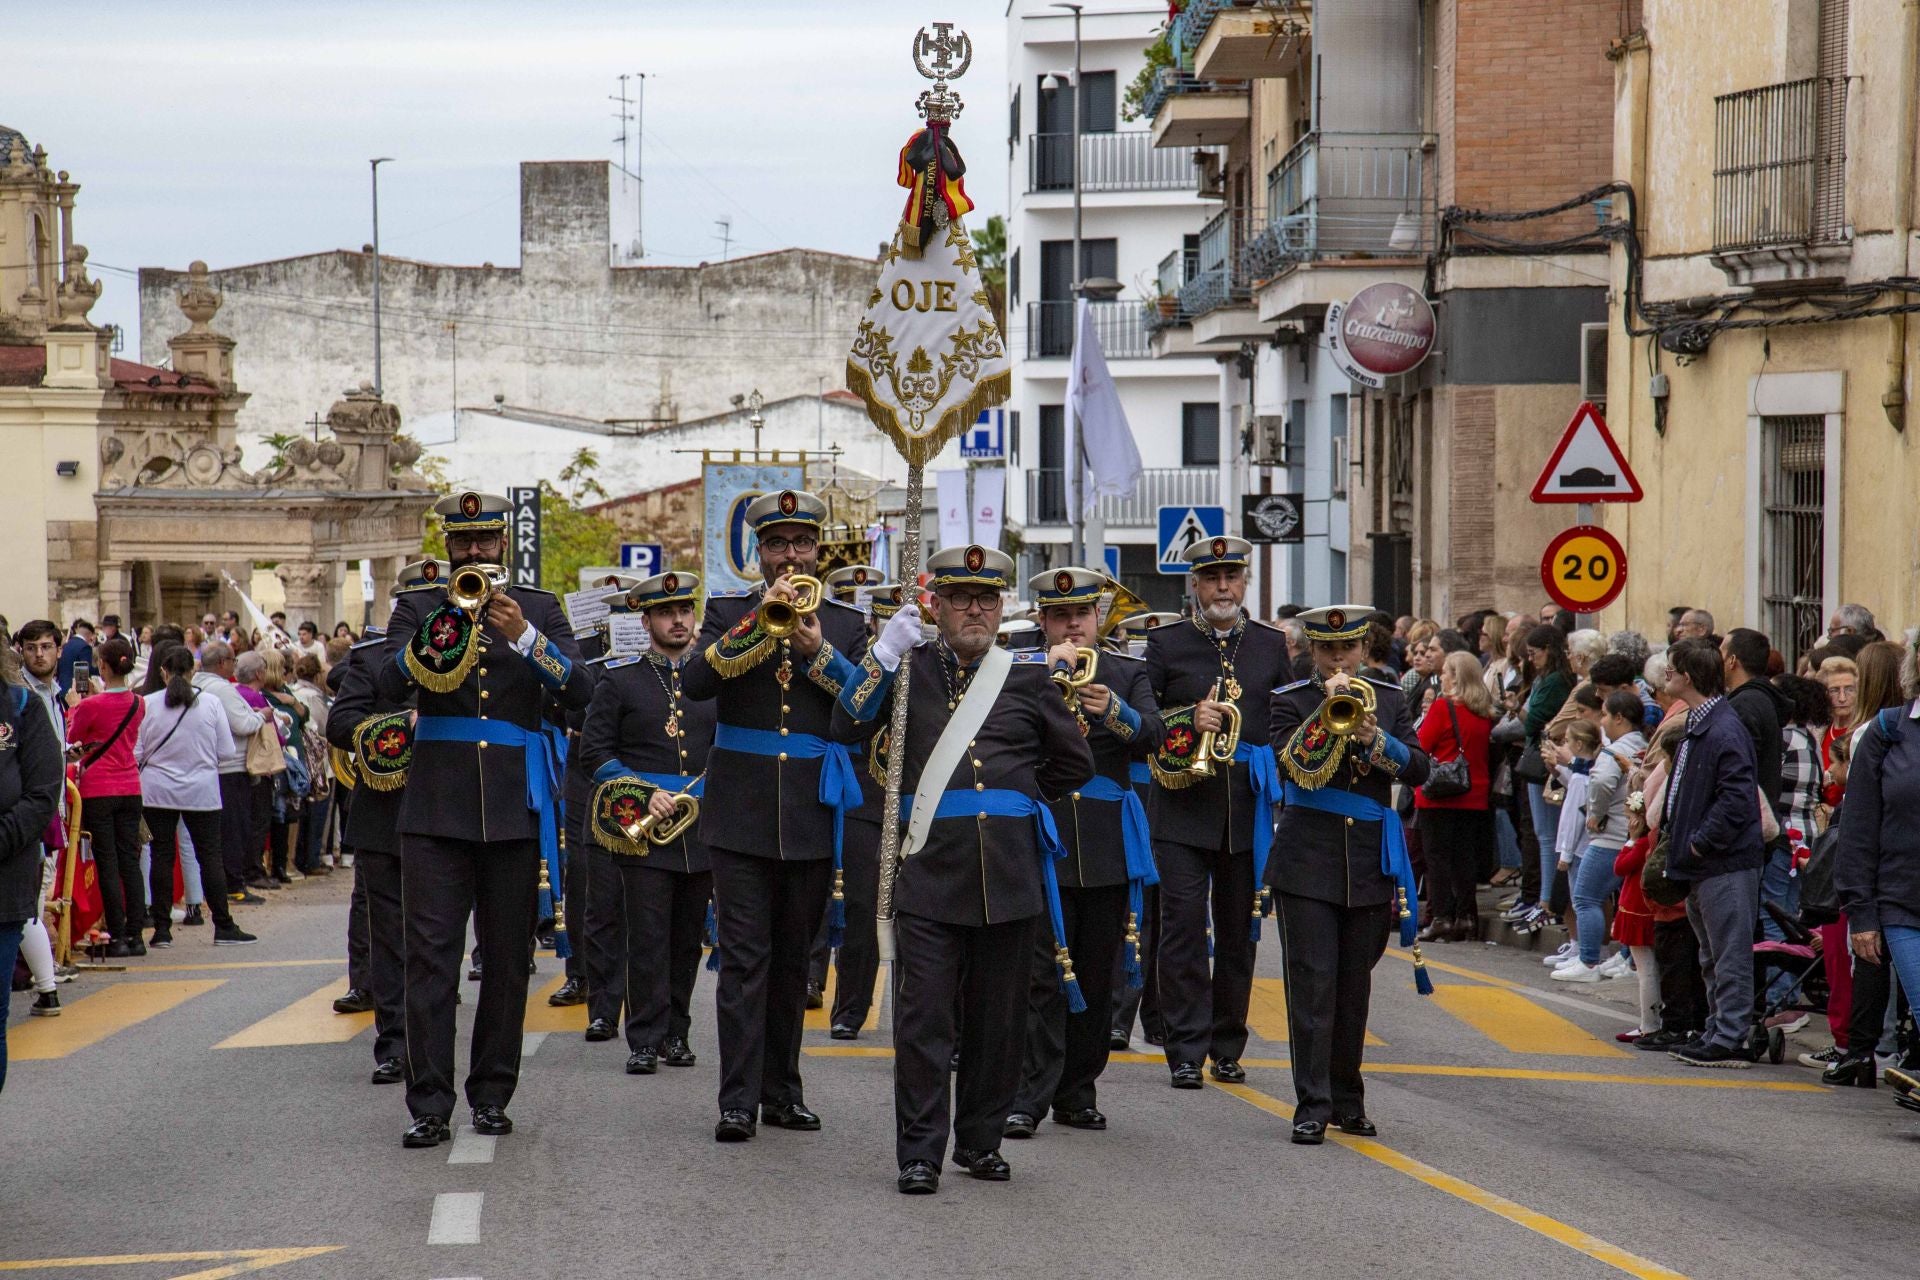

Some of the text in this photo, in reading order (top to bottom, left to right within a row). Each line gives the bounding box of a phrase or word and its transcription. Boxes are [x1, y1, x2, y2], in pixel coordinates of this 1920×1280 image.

[924, 187, 934, 217] HAZTE
[891, 279, 958, 313] OJE
[1345, 319, 1427, 350] Cruzcampo
[1345, 364, 1378, 387] HORNITO
[965, 406, 999, 448] H
[961, 449, 1002, 457] HOTEL
[516, 489, 536, 590] PARKIN
[630, 546, 653, 569] P
[1563, 554, 1609, 581] 20
